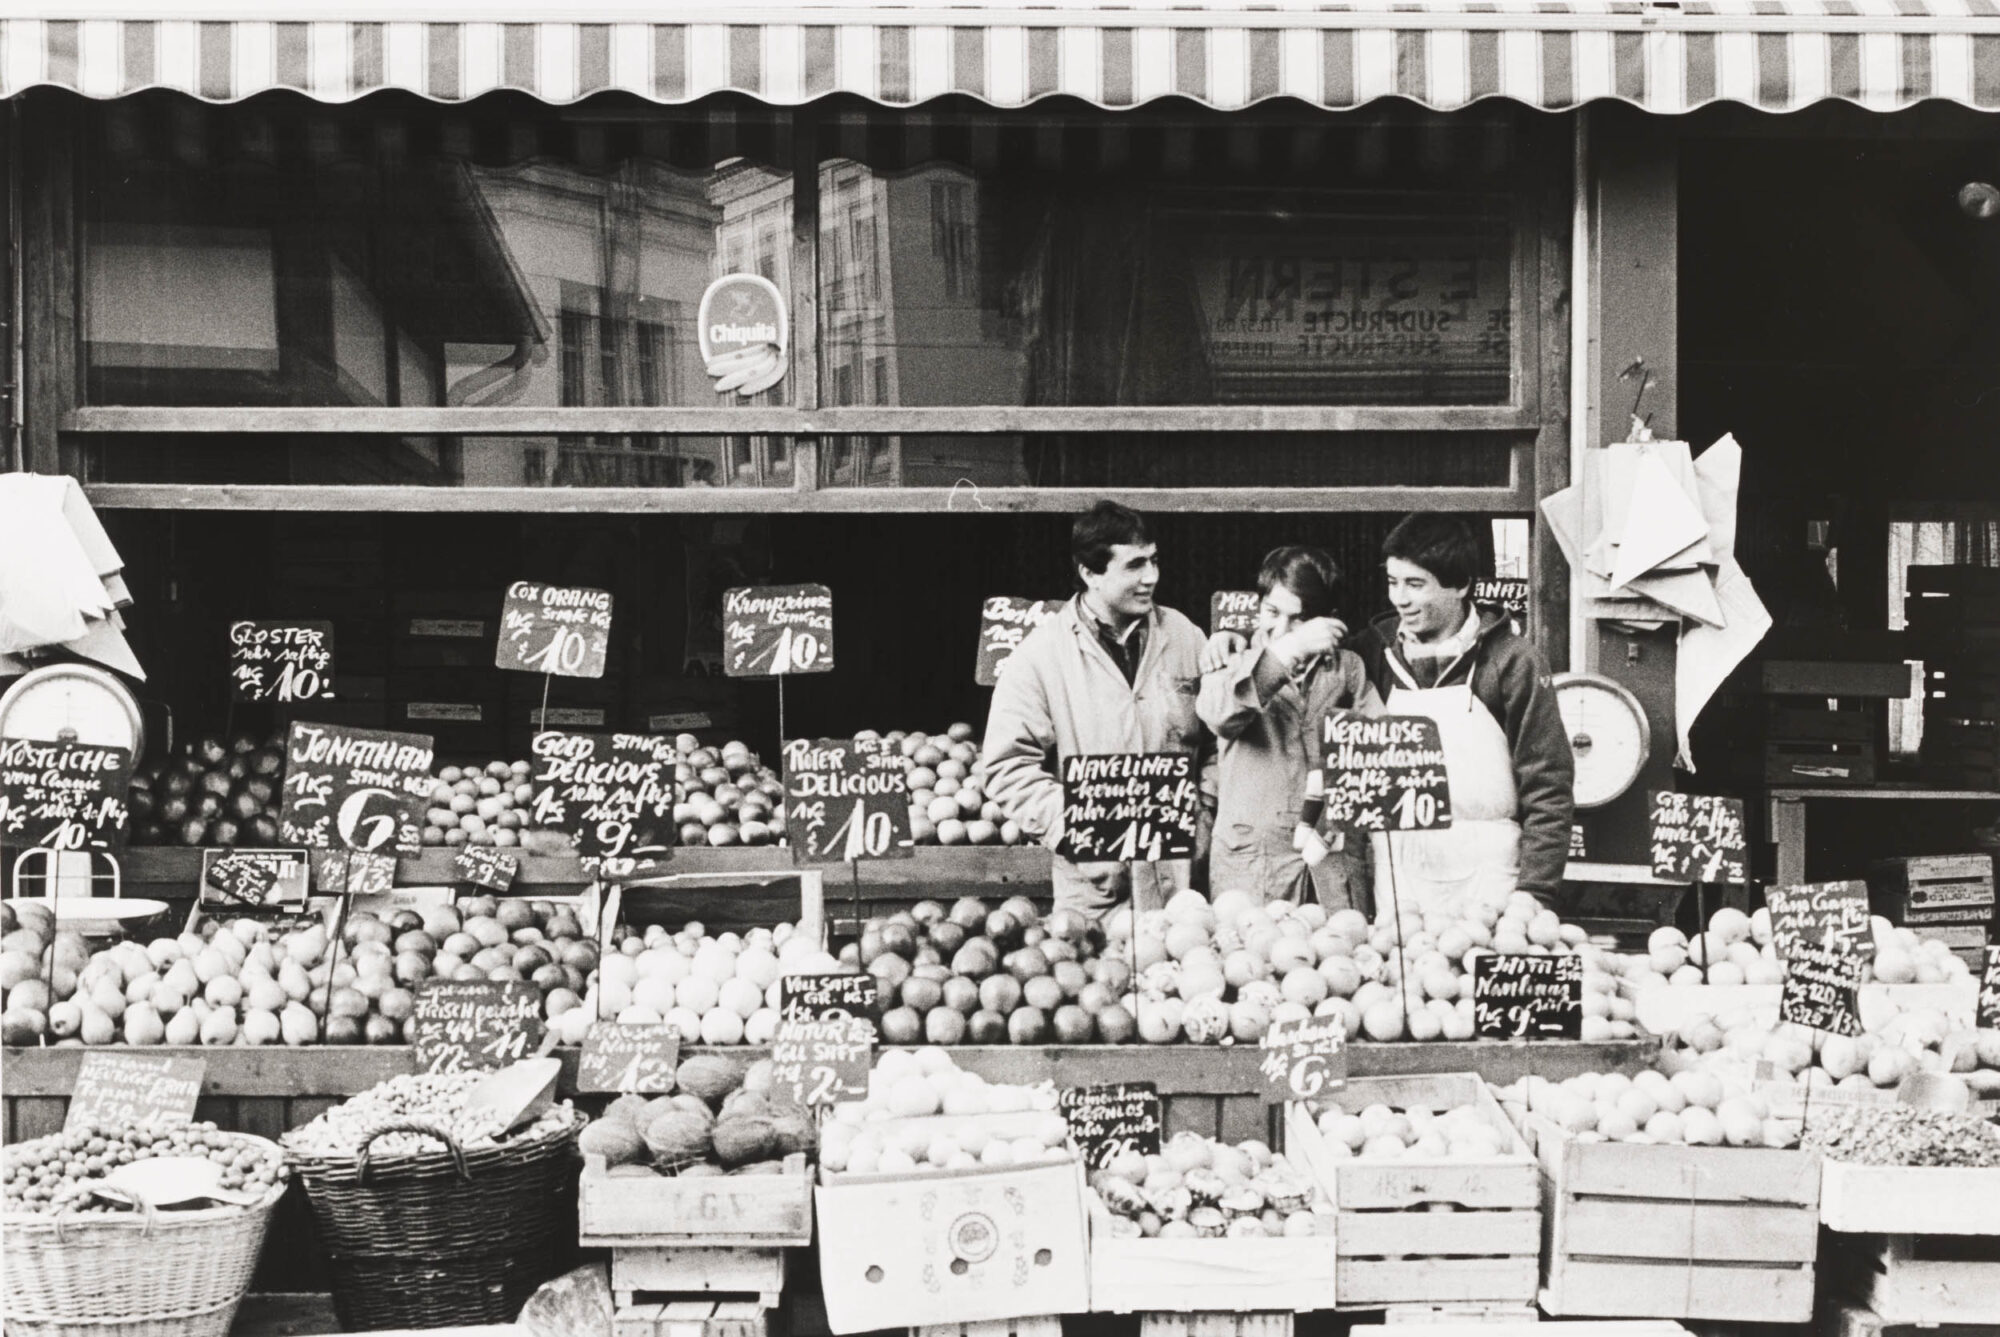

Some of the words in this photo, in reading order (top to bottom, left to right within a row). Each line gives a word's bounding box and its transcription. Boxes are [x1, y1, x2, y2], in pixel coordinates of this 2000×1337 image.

[710, 323, 777, 346] Chiquita
[541, 587, 610, 610] ORANG
[231, 621, 325, 646] GLOSTER
[1324, 712, 1428, 745] KERNLOSE
[1066, 755, 1190, 783] NAVELINAS
[789, 770, 906, 798] DELICIOUS
